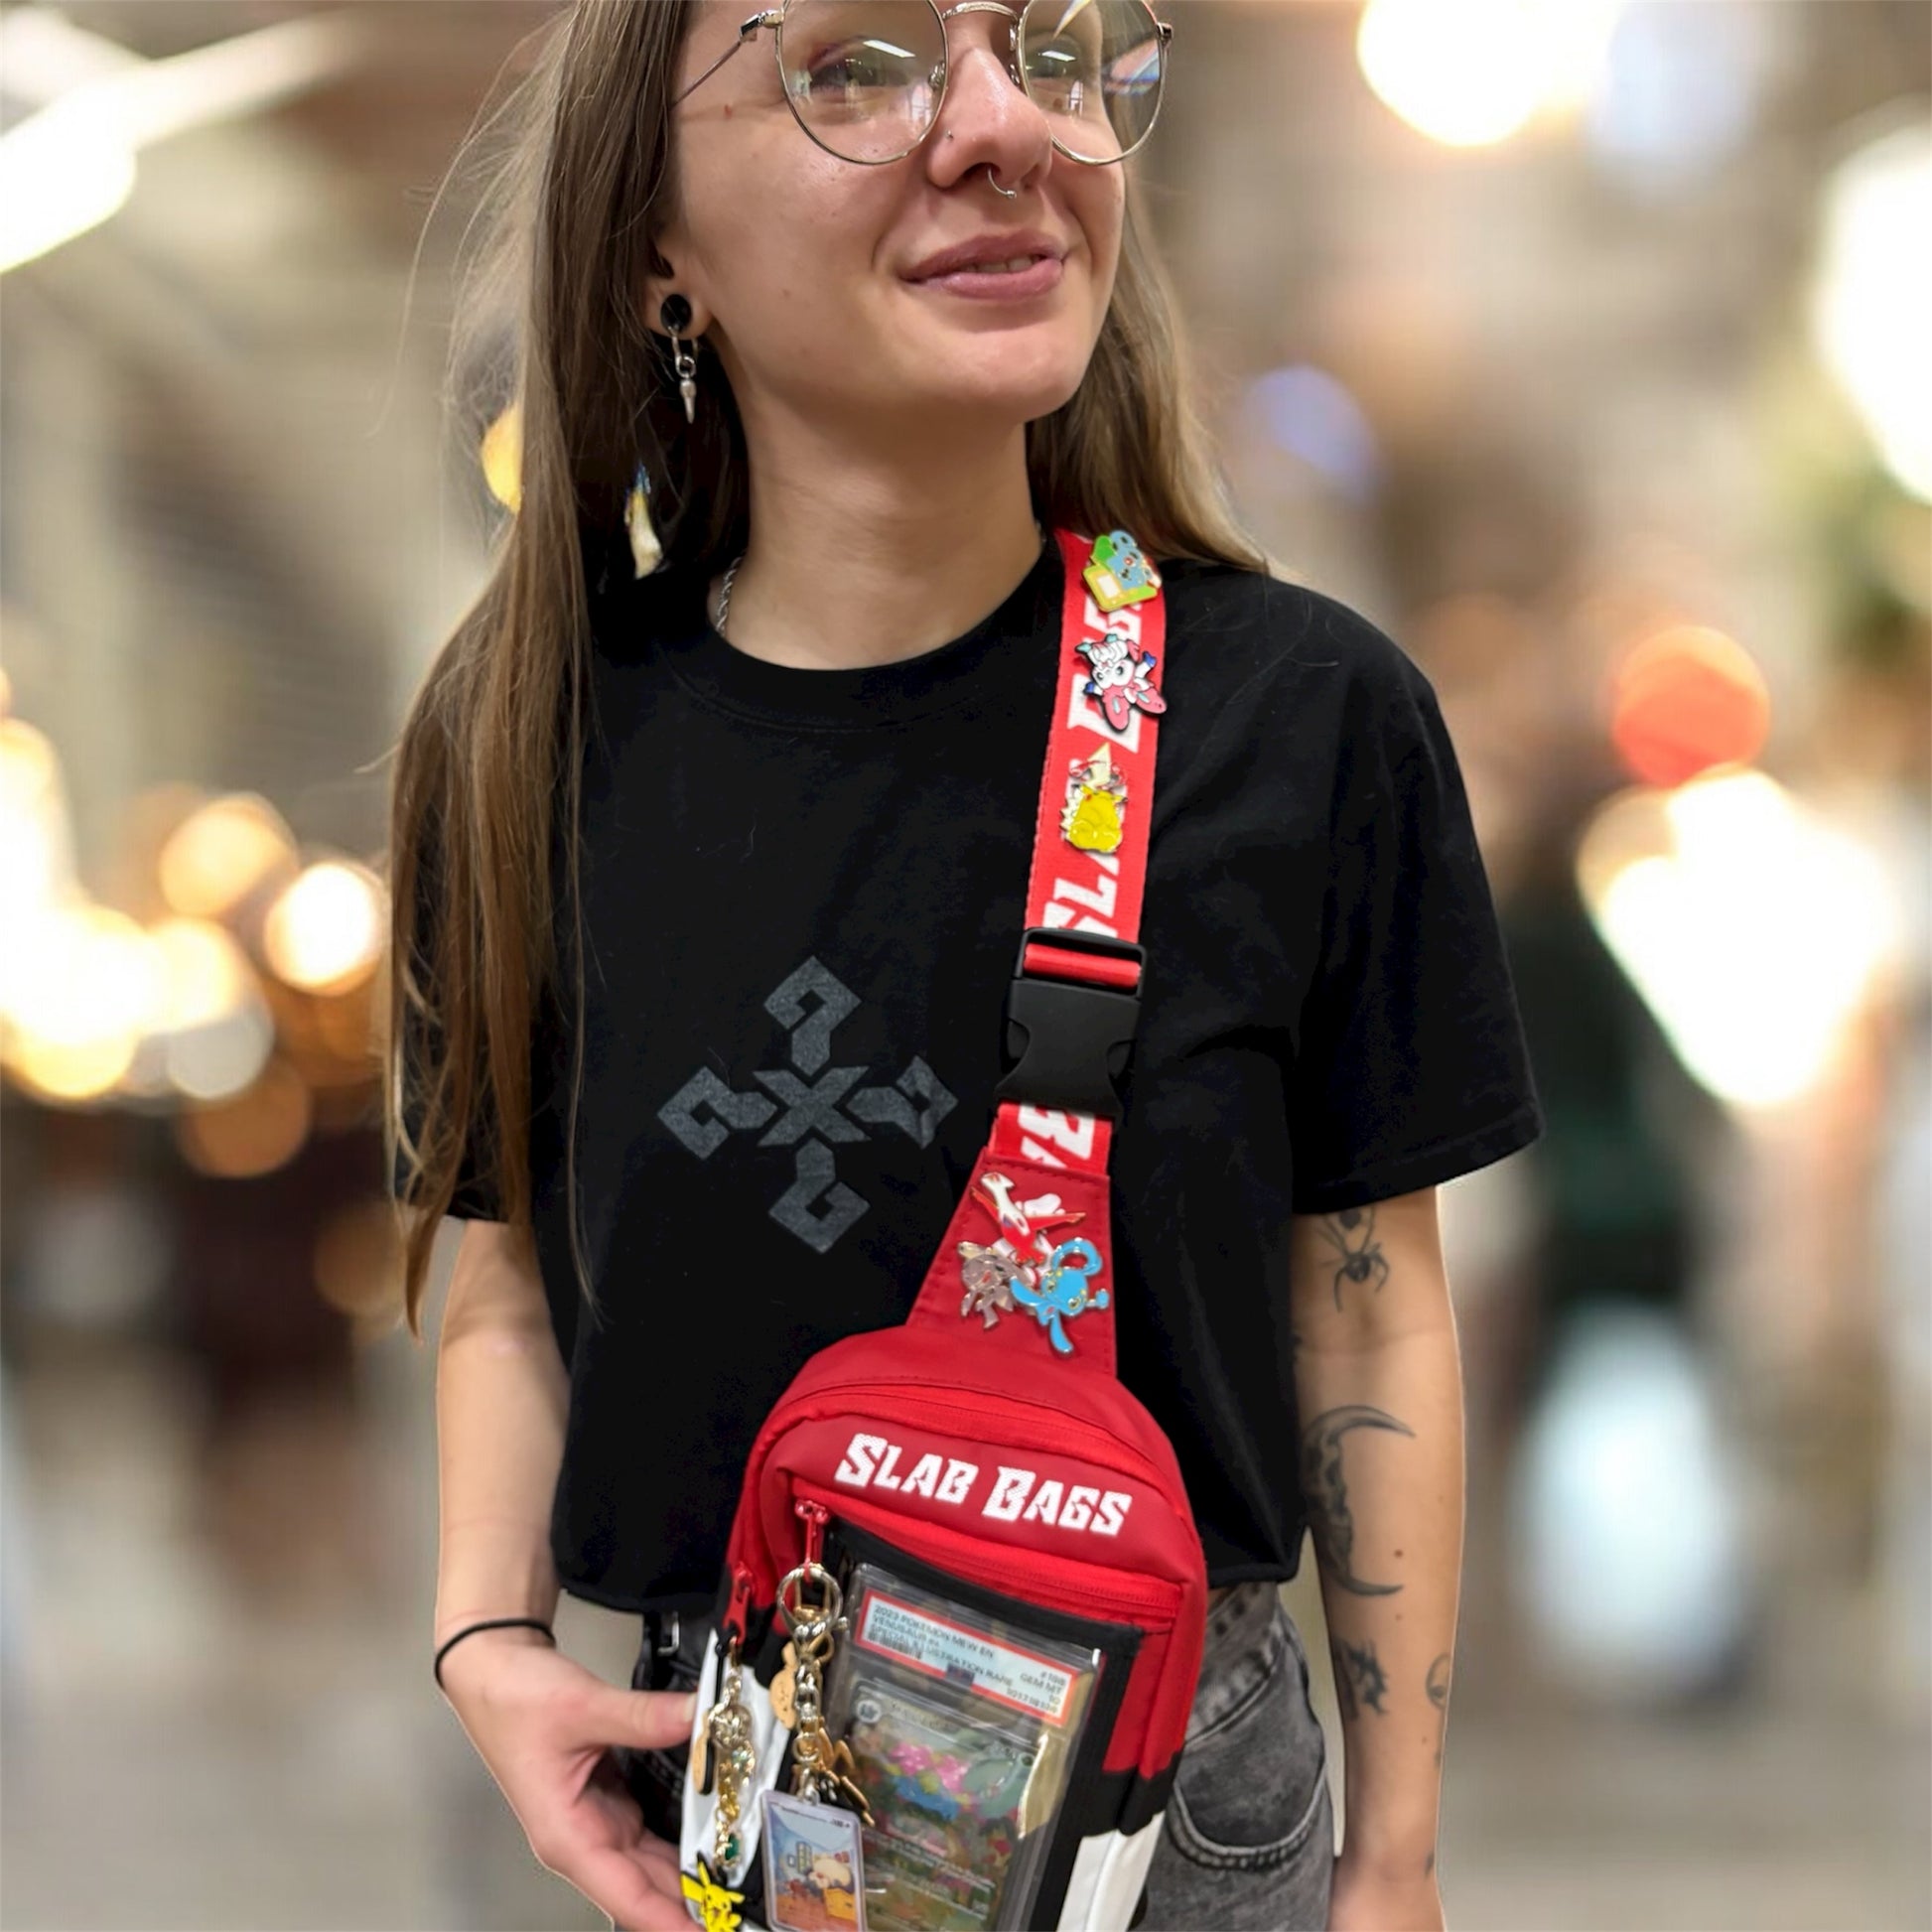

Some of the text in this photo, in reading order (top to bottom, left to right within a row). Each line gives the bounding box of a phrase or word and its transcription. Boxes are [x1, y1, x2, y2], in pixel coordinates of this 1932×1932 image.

[835, 1433, 1132, 1535] SLAB BAGS
[873, 1603, 898, 1621] 2023
[951, 1634, 978, 1652] MEW
